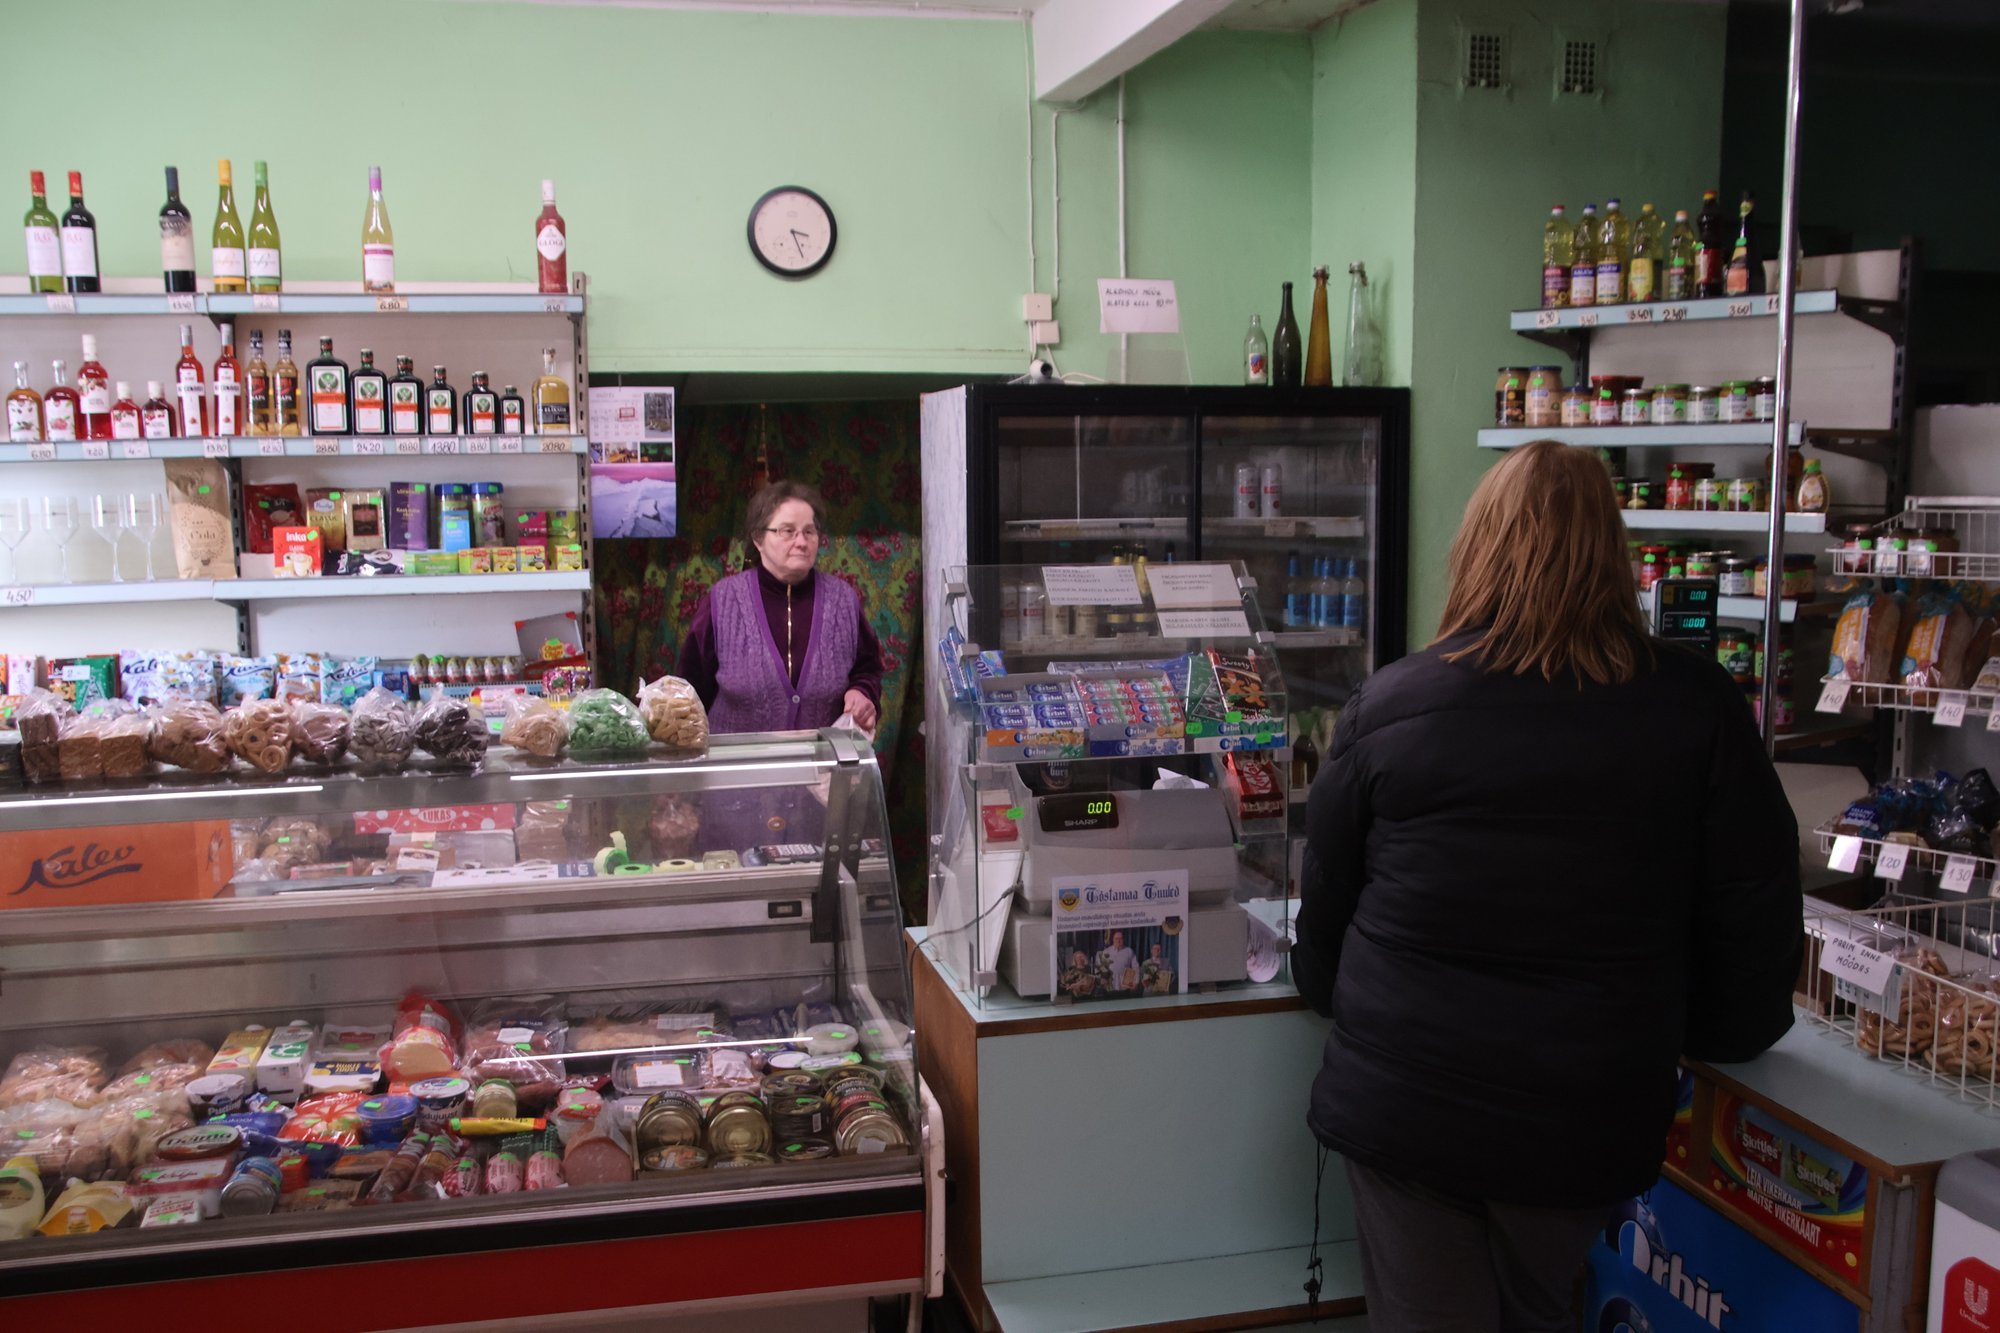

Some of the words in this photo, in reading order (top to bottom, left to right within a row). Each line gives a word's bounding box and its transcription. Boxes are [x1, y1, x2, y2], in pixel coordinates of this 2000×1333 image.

[286, 532, 307, 542] inka
[423, 809, 452, 821] LUKAS
[1087, 801, 1112, 814] 0.00
[1064, 818, 1099, 828] SHARP
[7, 842, 144, 896] Kalev
[1832, 937, 1857, 954] PARIM
[1860, 947, 1882, 963] ENNE
[1742, 1132, 1779, 1160] Skittles
[1746, 1165, 1761, 1189] LEIA
[1762, 1179, 1803, 1211] VIKERKAAR
[1796, 1165, 1837, 1195] Skittles
[1746, 1188, 1774, 1215] MAITSE
[1774, 1204, 1822, 1248] VIKERKAART
[1611, 1212, 1731, 1330] Orbit
